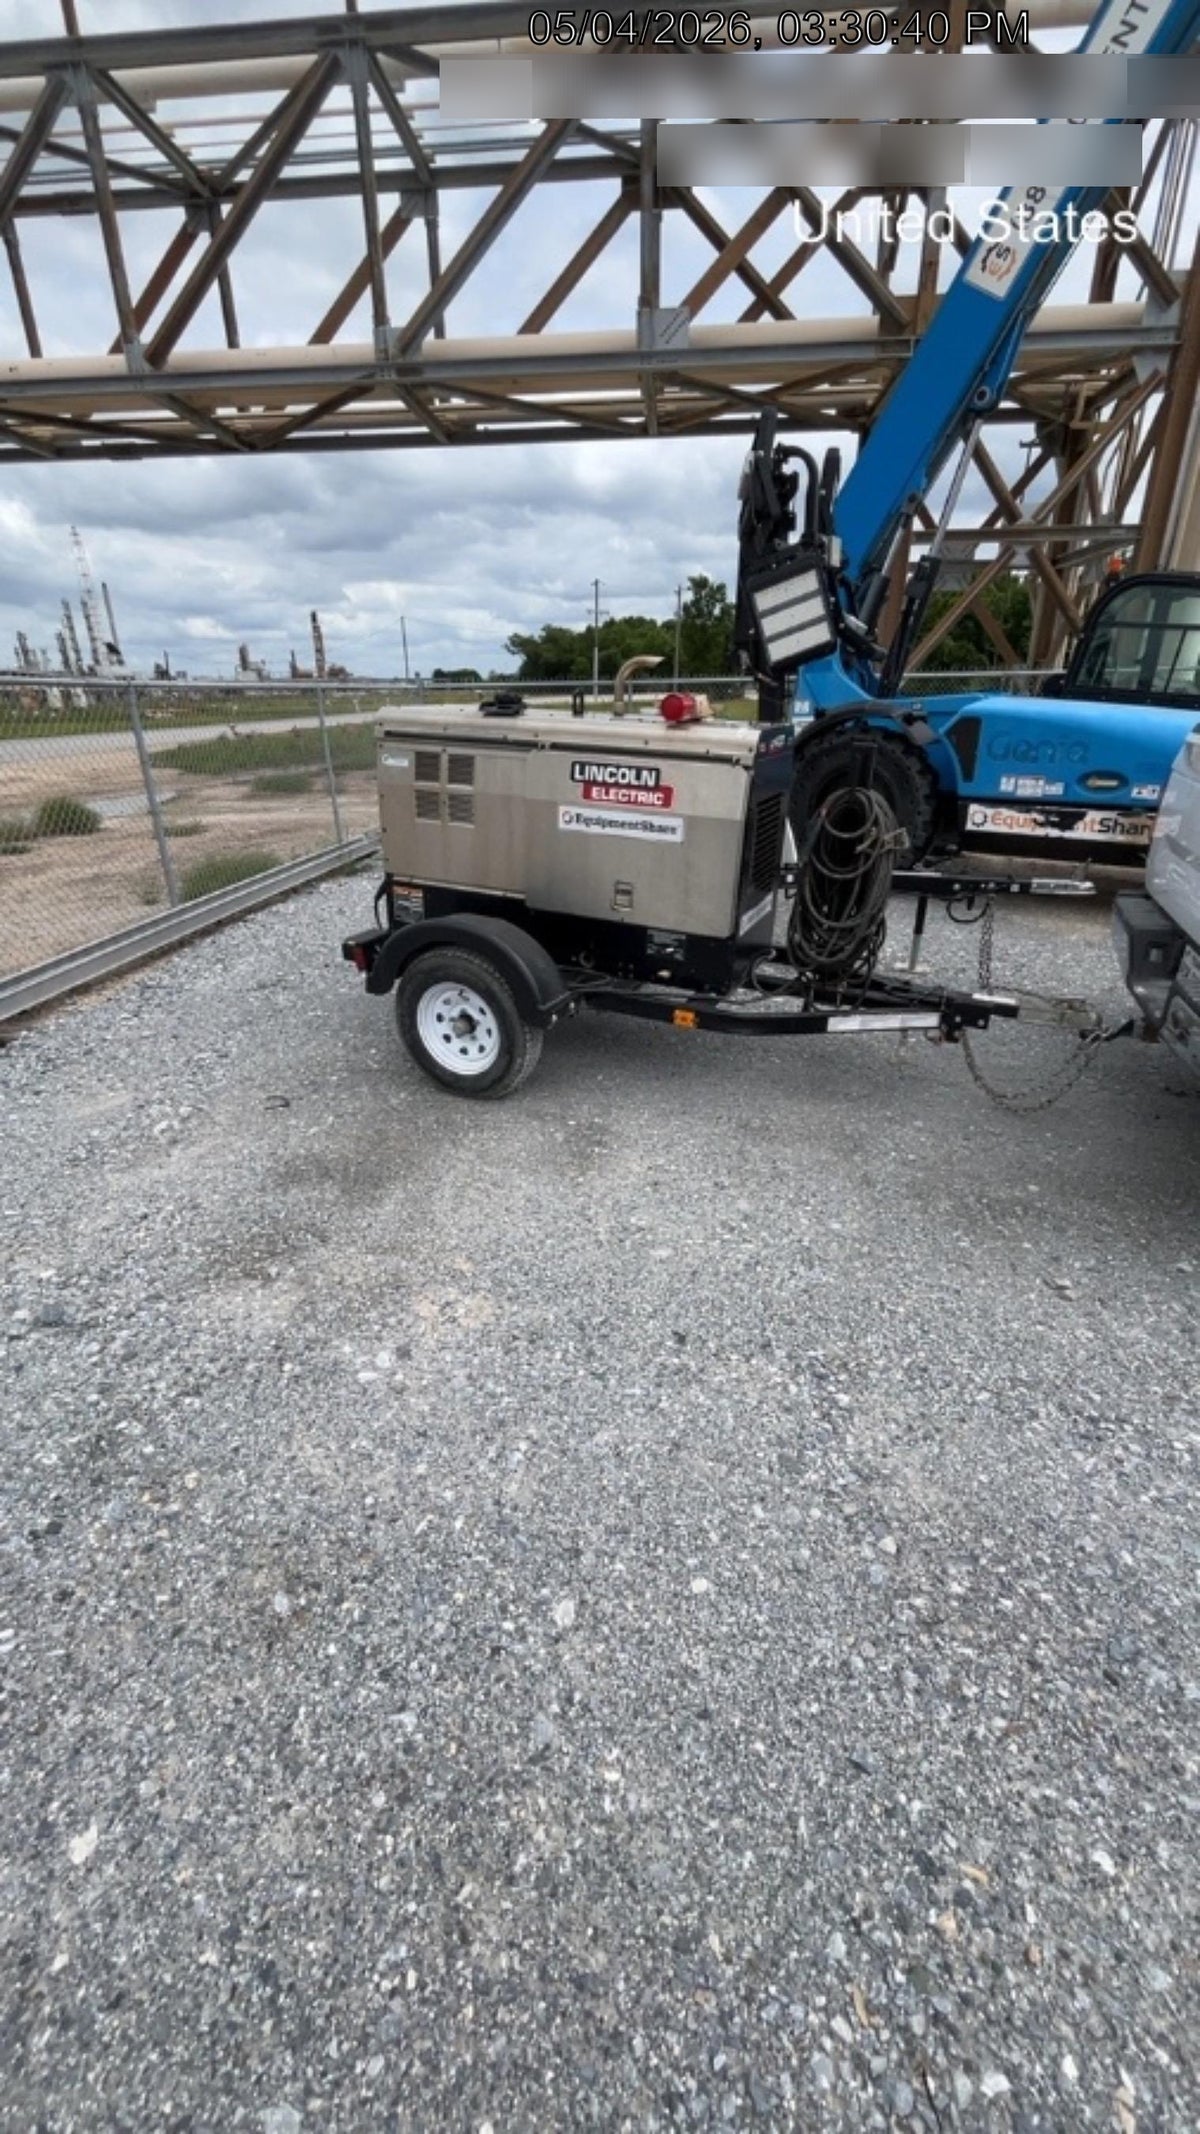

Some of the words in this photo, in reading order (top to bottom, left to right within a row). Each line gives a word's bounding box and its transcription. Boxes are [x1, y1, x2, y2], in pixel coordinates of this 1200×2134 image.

[573, 762, 657, 787] LINCOLN
[591, 786, 665, 806] ELECTRIC
[575, 812, 678, 836] EquipmentShare
